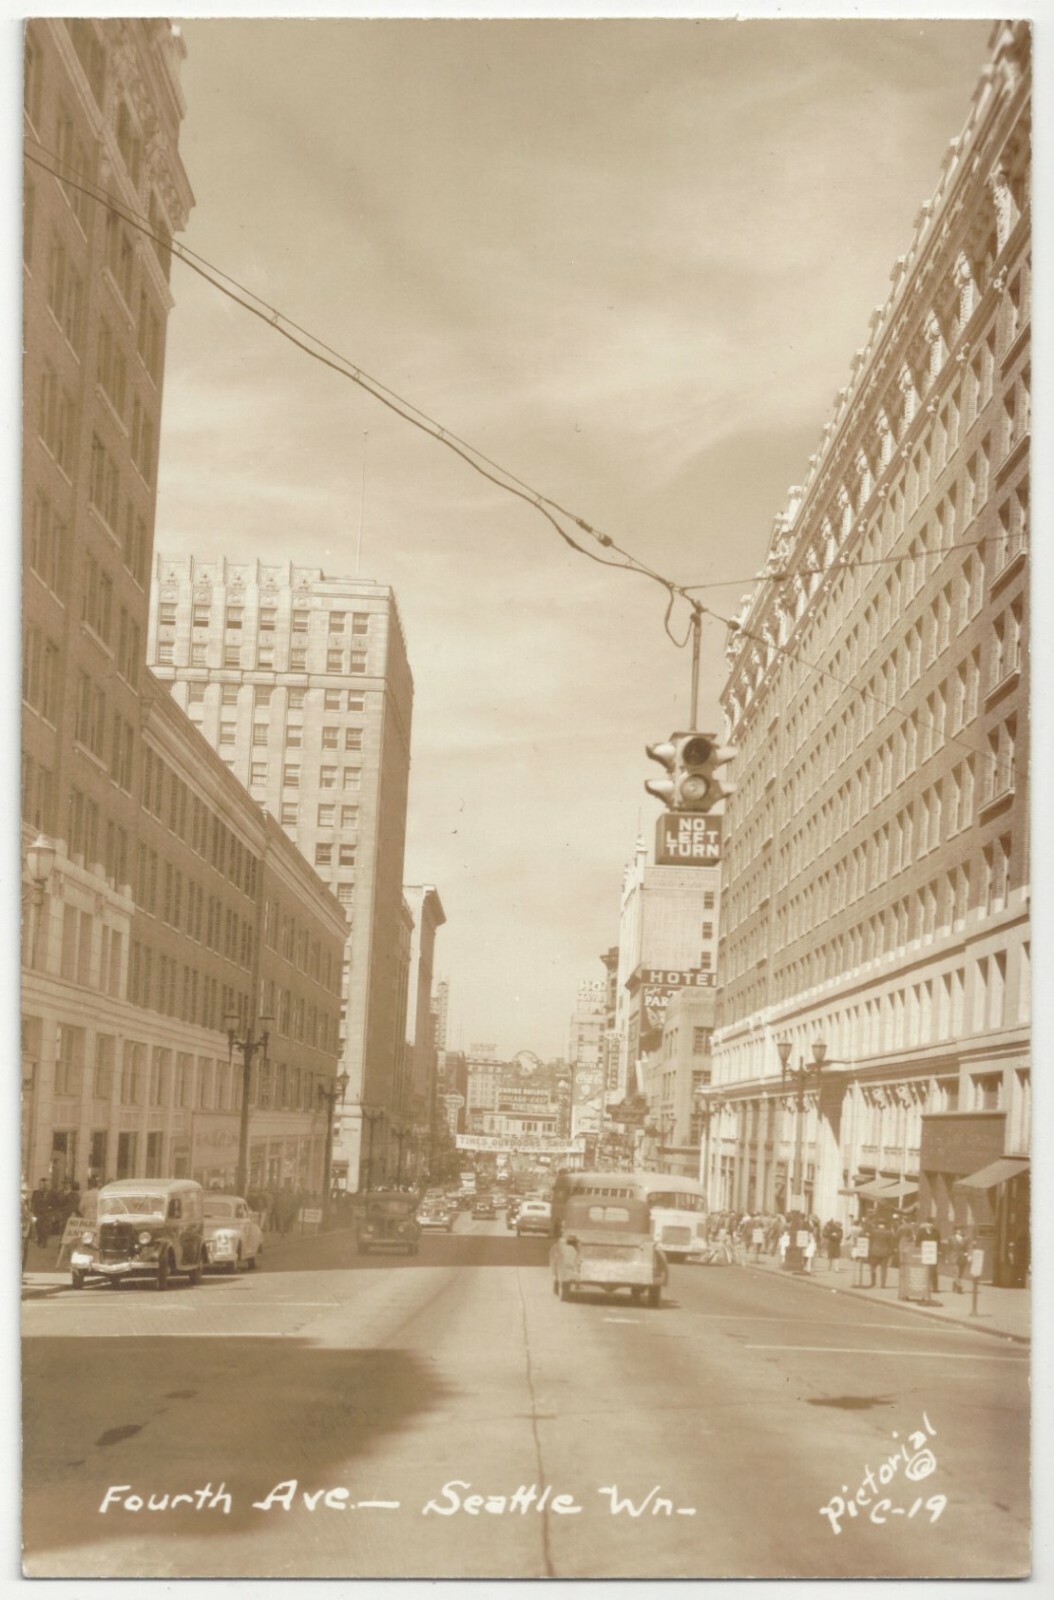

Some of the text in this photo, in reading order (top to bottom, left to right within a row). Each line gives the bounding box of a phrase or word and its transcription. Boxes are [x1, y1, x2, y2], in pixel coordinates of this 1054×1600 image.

[679, 817, 706, 832] NO
[666, 830, 719, 844] LEFT
[666, 843, 720, 857] TURN
